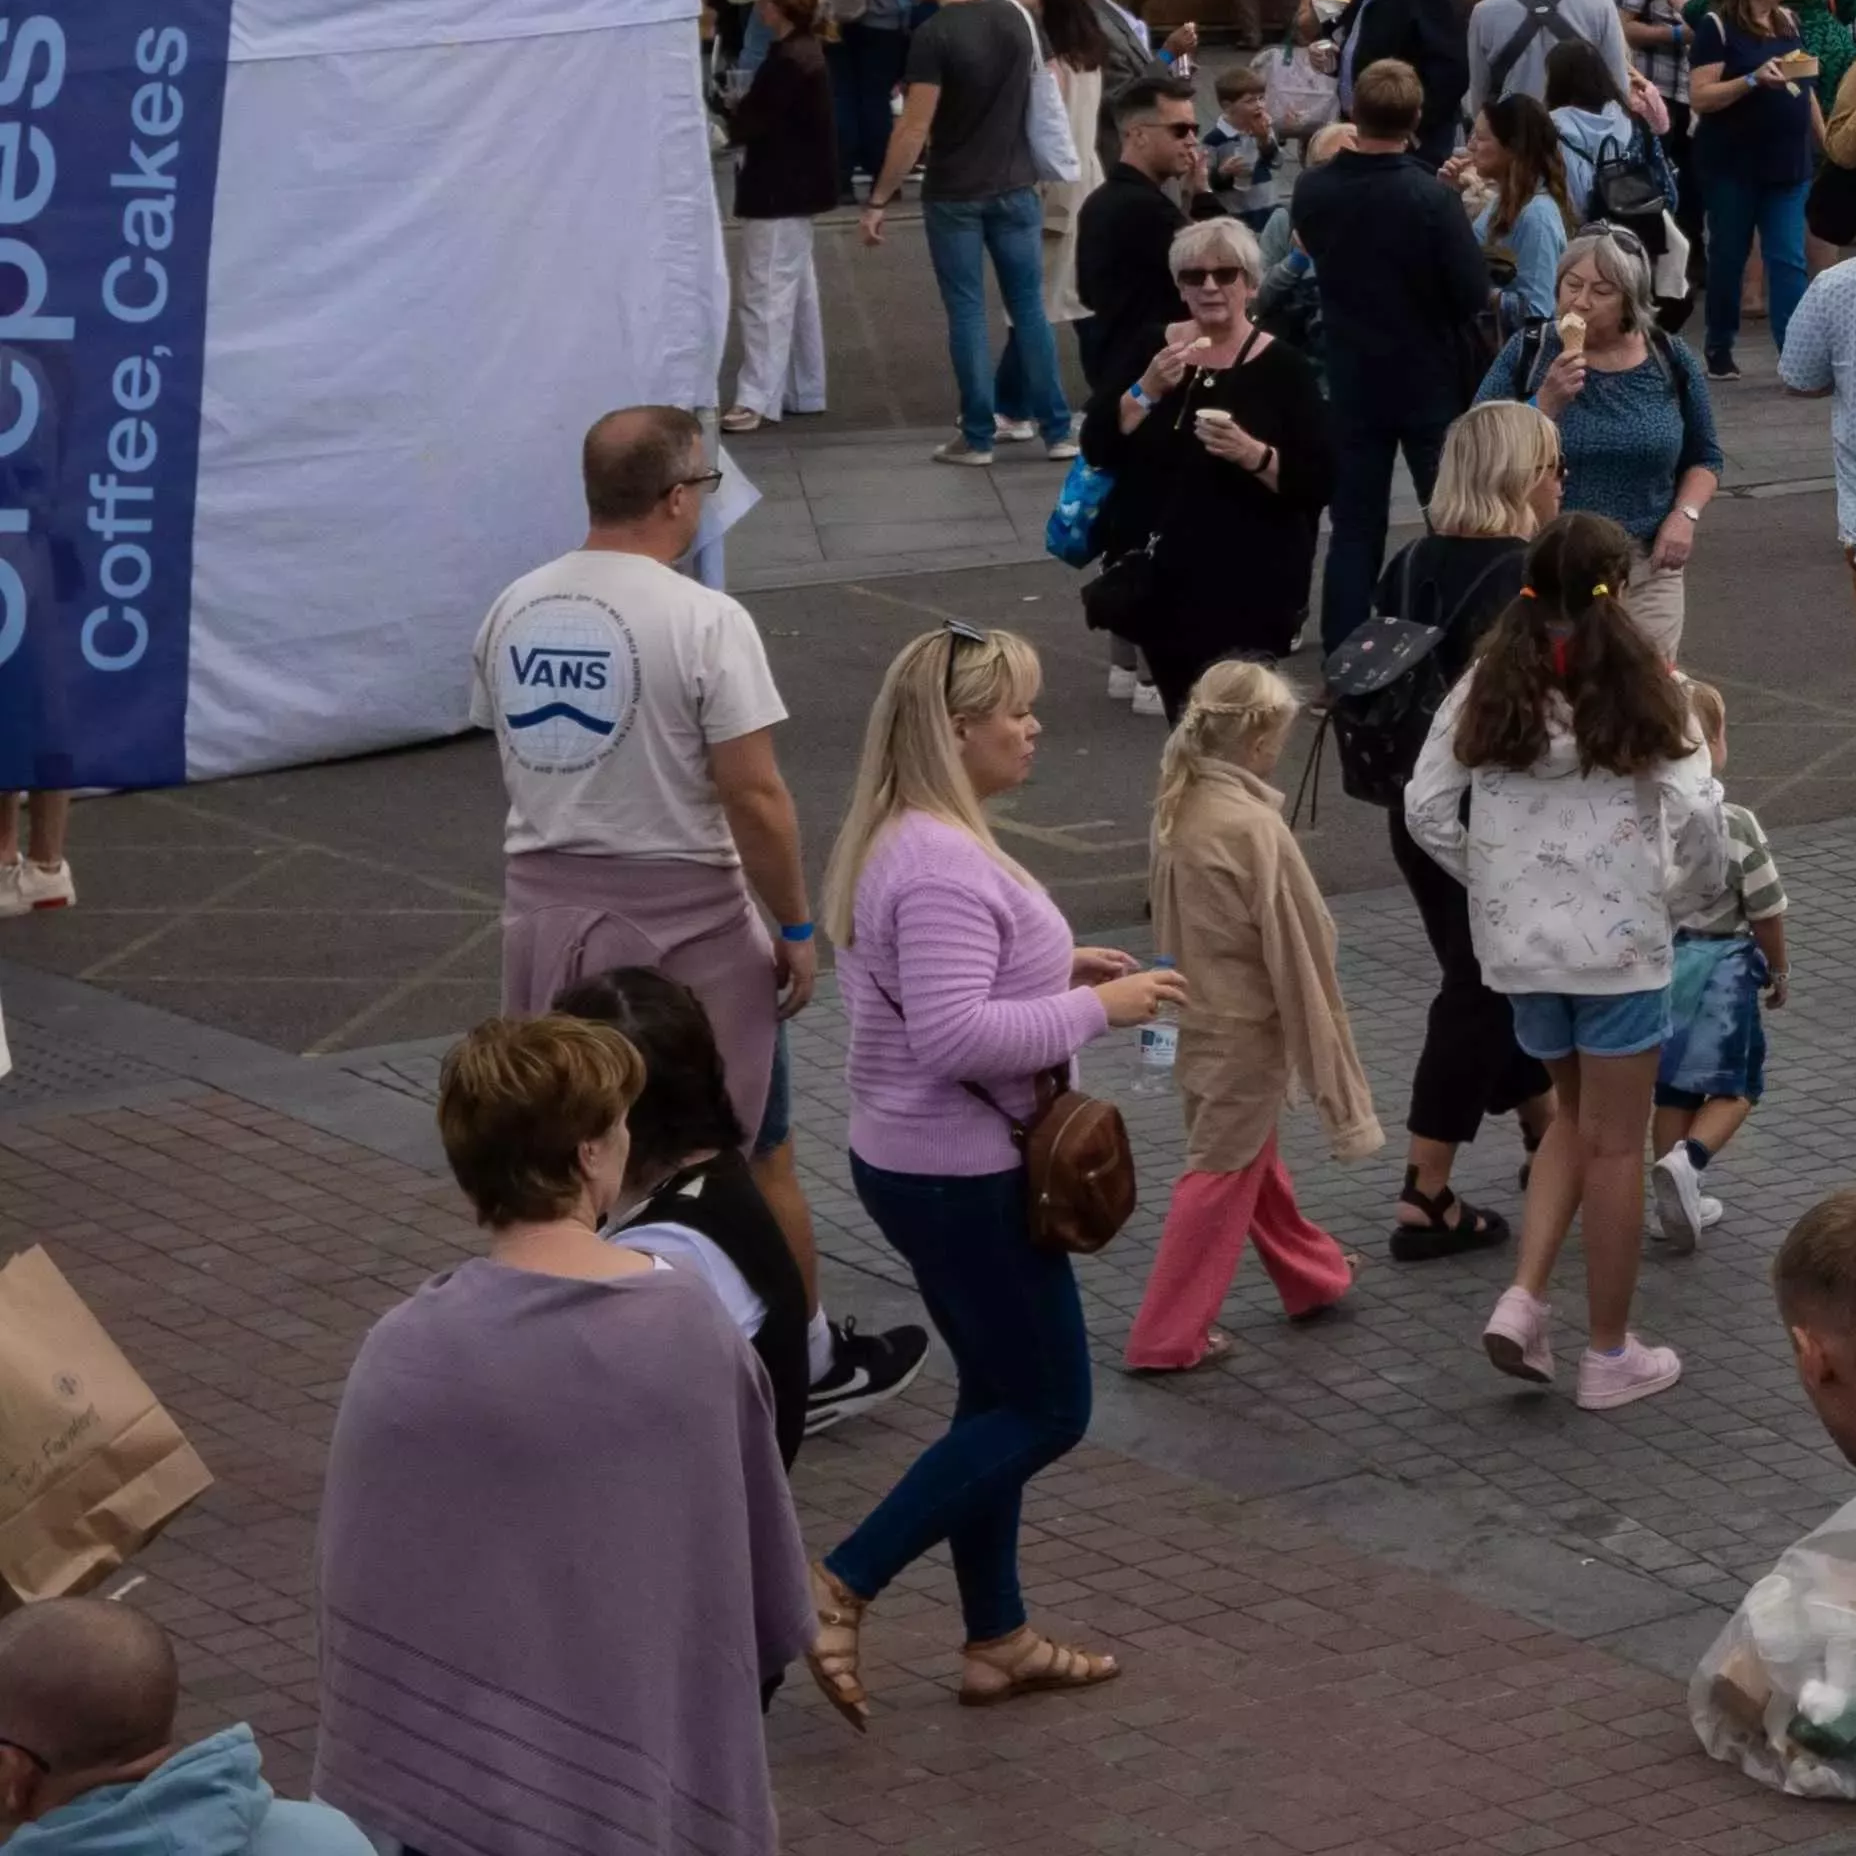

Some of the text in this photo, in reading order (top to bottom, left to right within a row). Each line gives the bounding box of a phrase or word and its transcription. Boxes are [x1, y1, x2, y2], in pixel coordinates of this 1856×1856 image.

[81, 26, 188, 672] Coffee, Cakes
[509, 644, 612, 691] VANS
